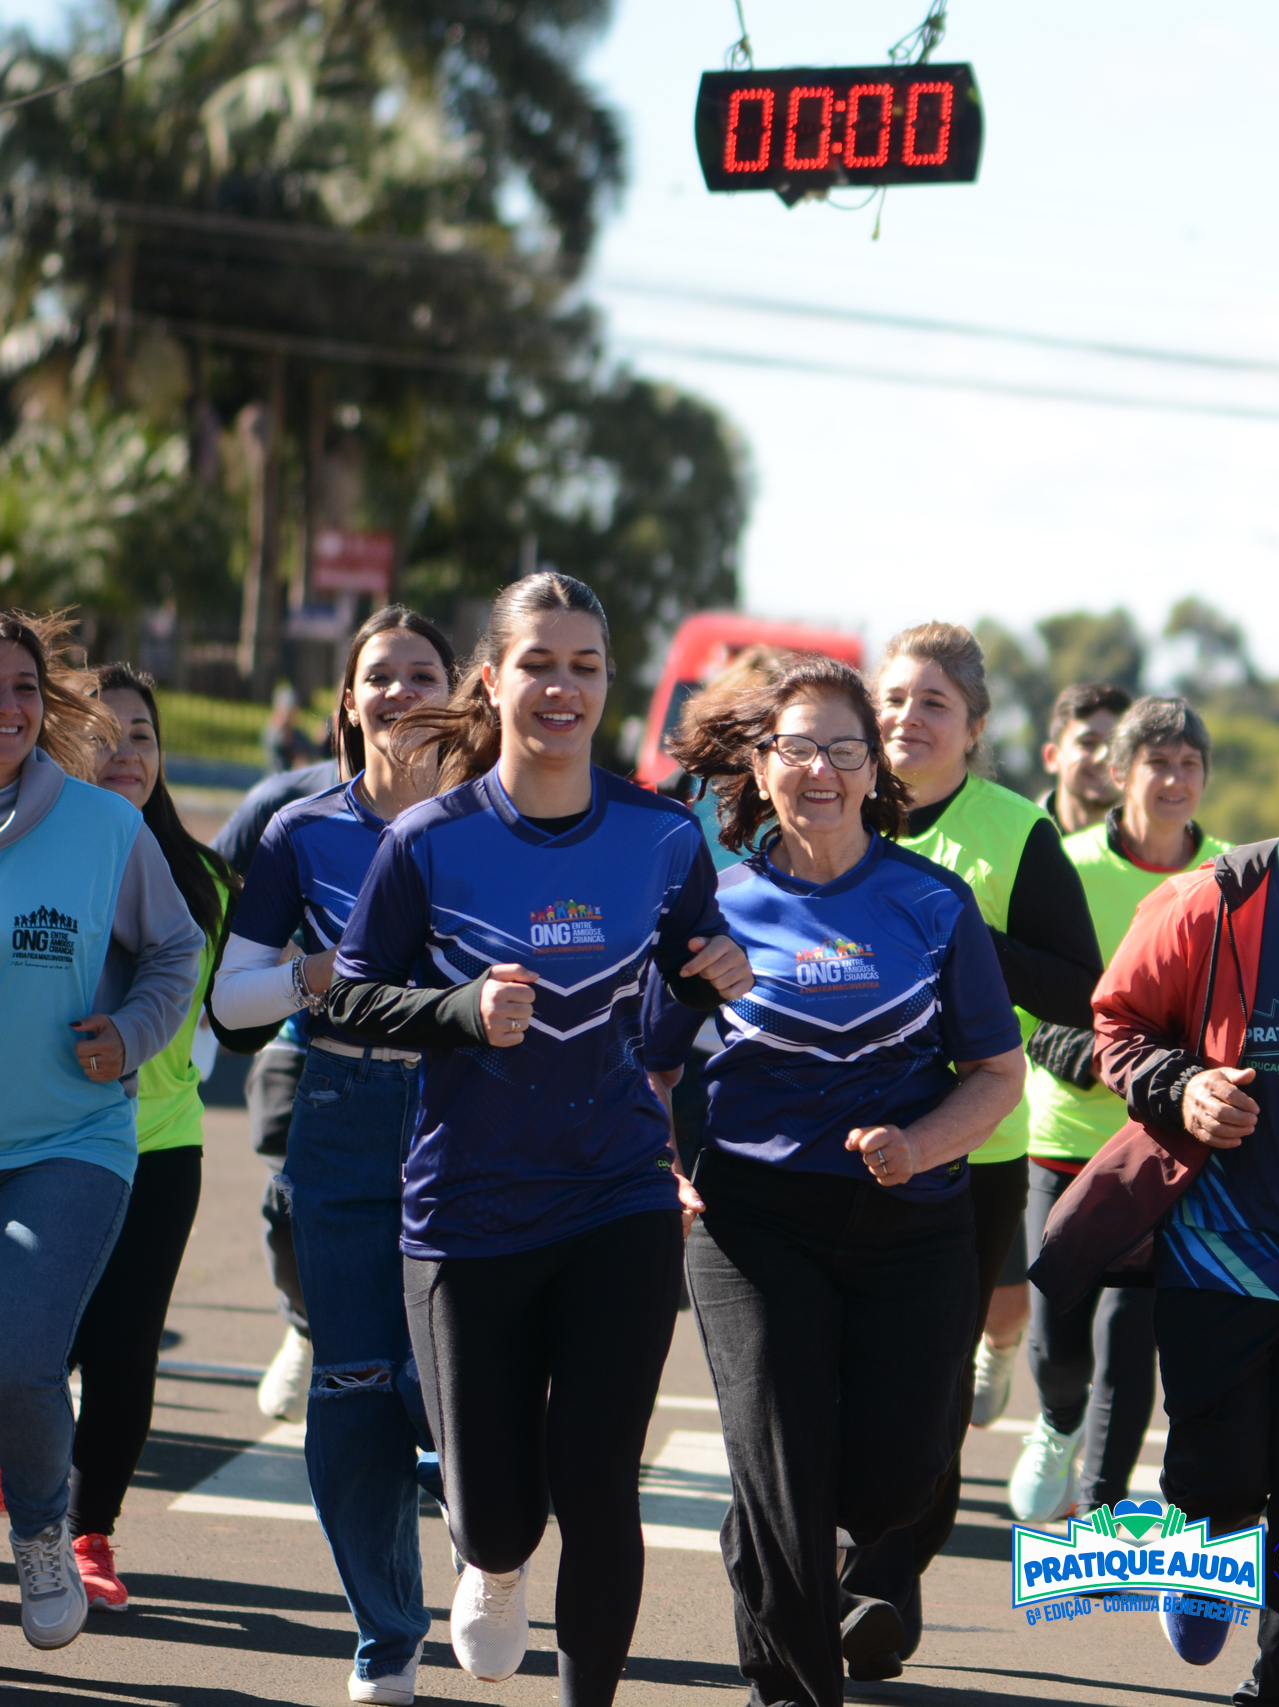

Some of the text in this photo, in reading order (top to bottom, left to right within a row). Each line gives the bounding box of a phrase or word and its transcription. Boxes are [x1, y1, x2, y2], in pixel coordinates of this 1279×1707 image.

[531, 923, 571, 946] ONG
[572, 921, 593, 930] ENTRE
[13, 929, 49, 951] ONG
[796, 960, 842, 986] ONG
[842, 958, 865, 967] ENTRE
